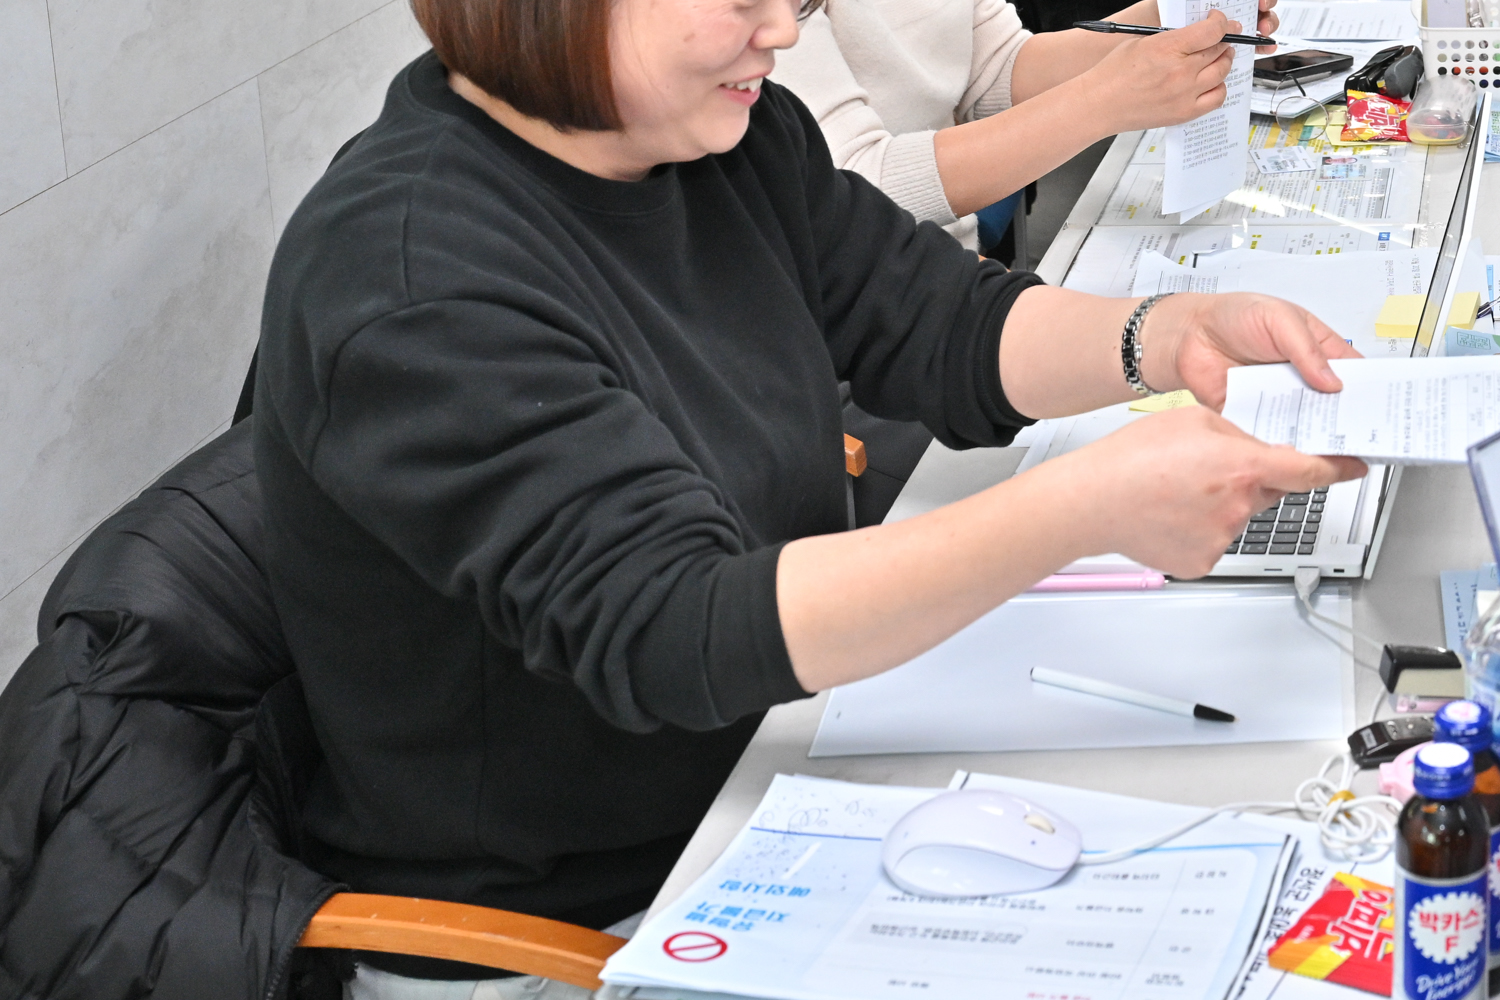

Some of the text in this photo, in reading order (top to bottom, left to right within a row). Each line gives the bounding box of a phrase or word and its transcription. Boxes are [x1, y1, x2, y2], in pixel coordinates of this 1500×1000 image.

[1285, 867, 1325, 902] 정선군
[1419, 909, 1481, 933] 박카스
[1445, 938, 1458, 954] F
[1416, 972, 1453, 993] Drive
